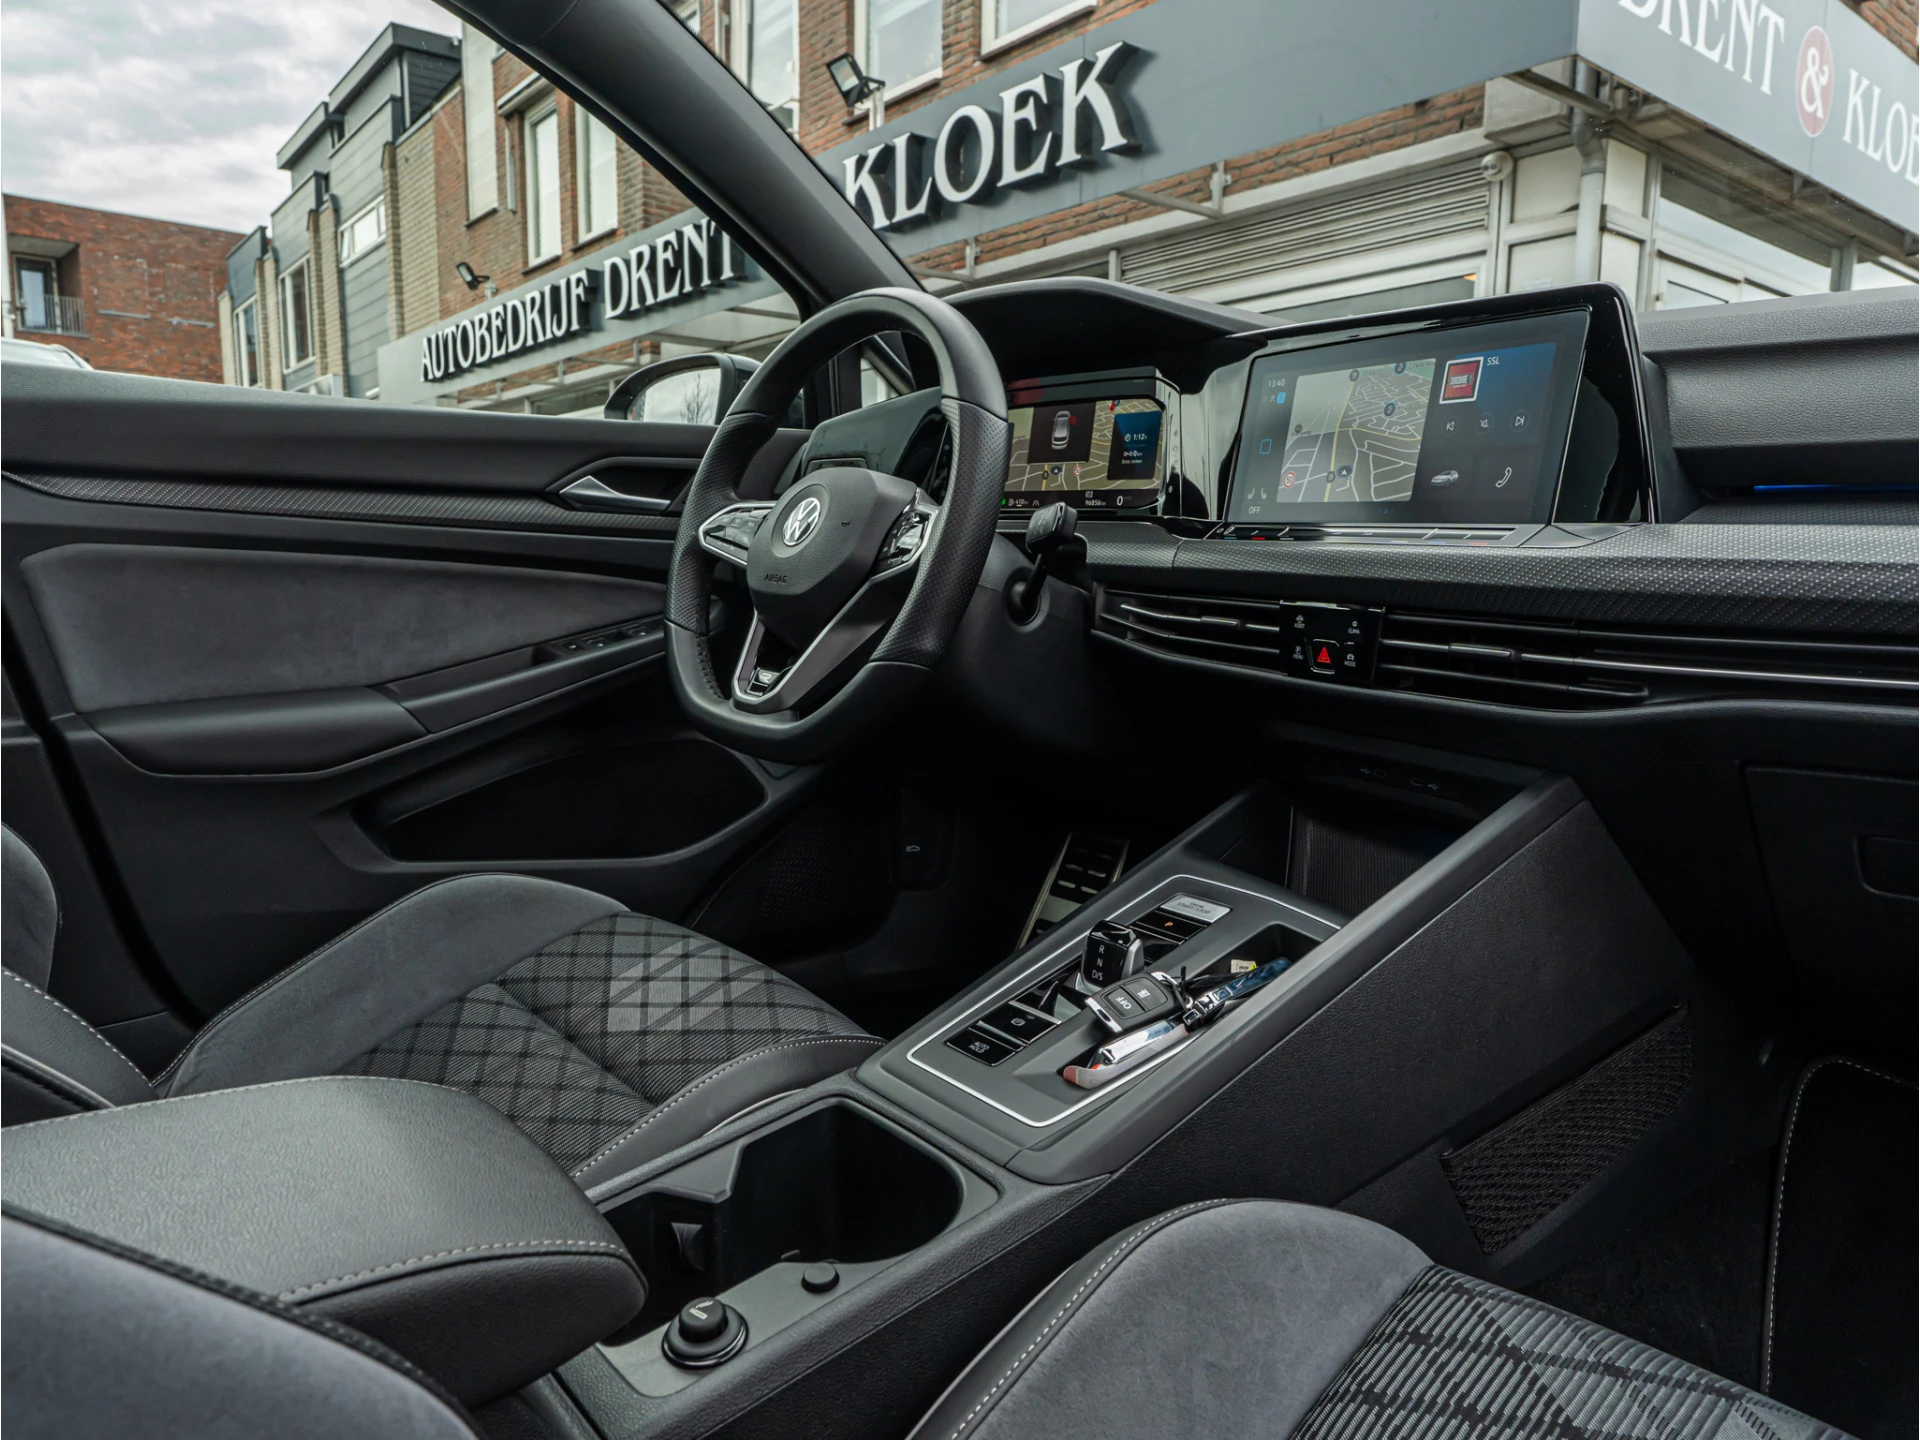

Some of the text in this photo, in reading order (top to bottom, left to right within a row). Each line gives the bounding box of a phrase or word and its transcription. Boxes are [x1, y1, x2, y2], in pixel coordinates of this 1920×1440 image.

[1617, 0, 1785, 96] ENT
[1801, 47, 1829, 119] &
[420, 41, 1128, 382] AUTOBEDRIJF DRENT KLOEK
[1098, 944, 1105, 954] R
[1096, 958, 1103, 968] N
[1115, 996, 1132, 1010] OFF
